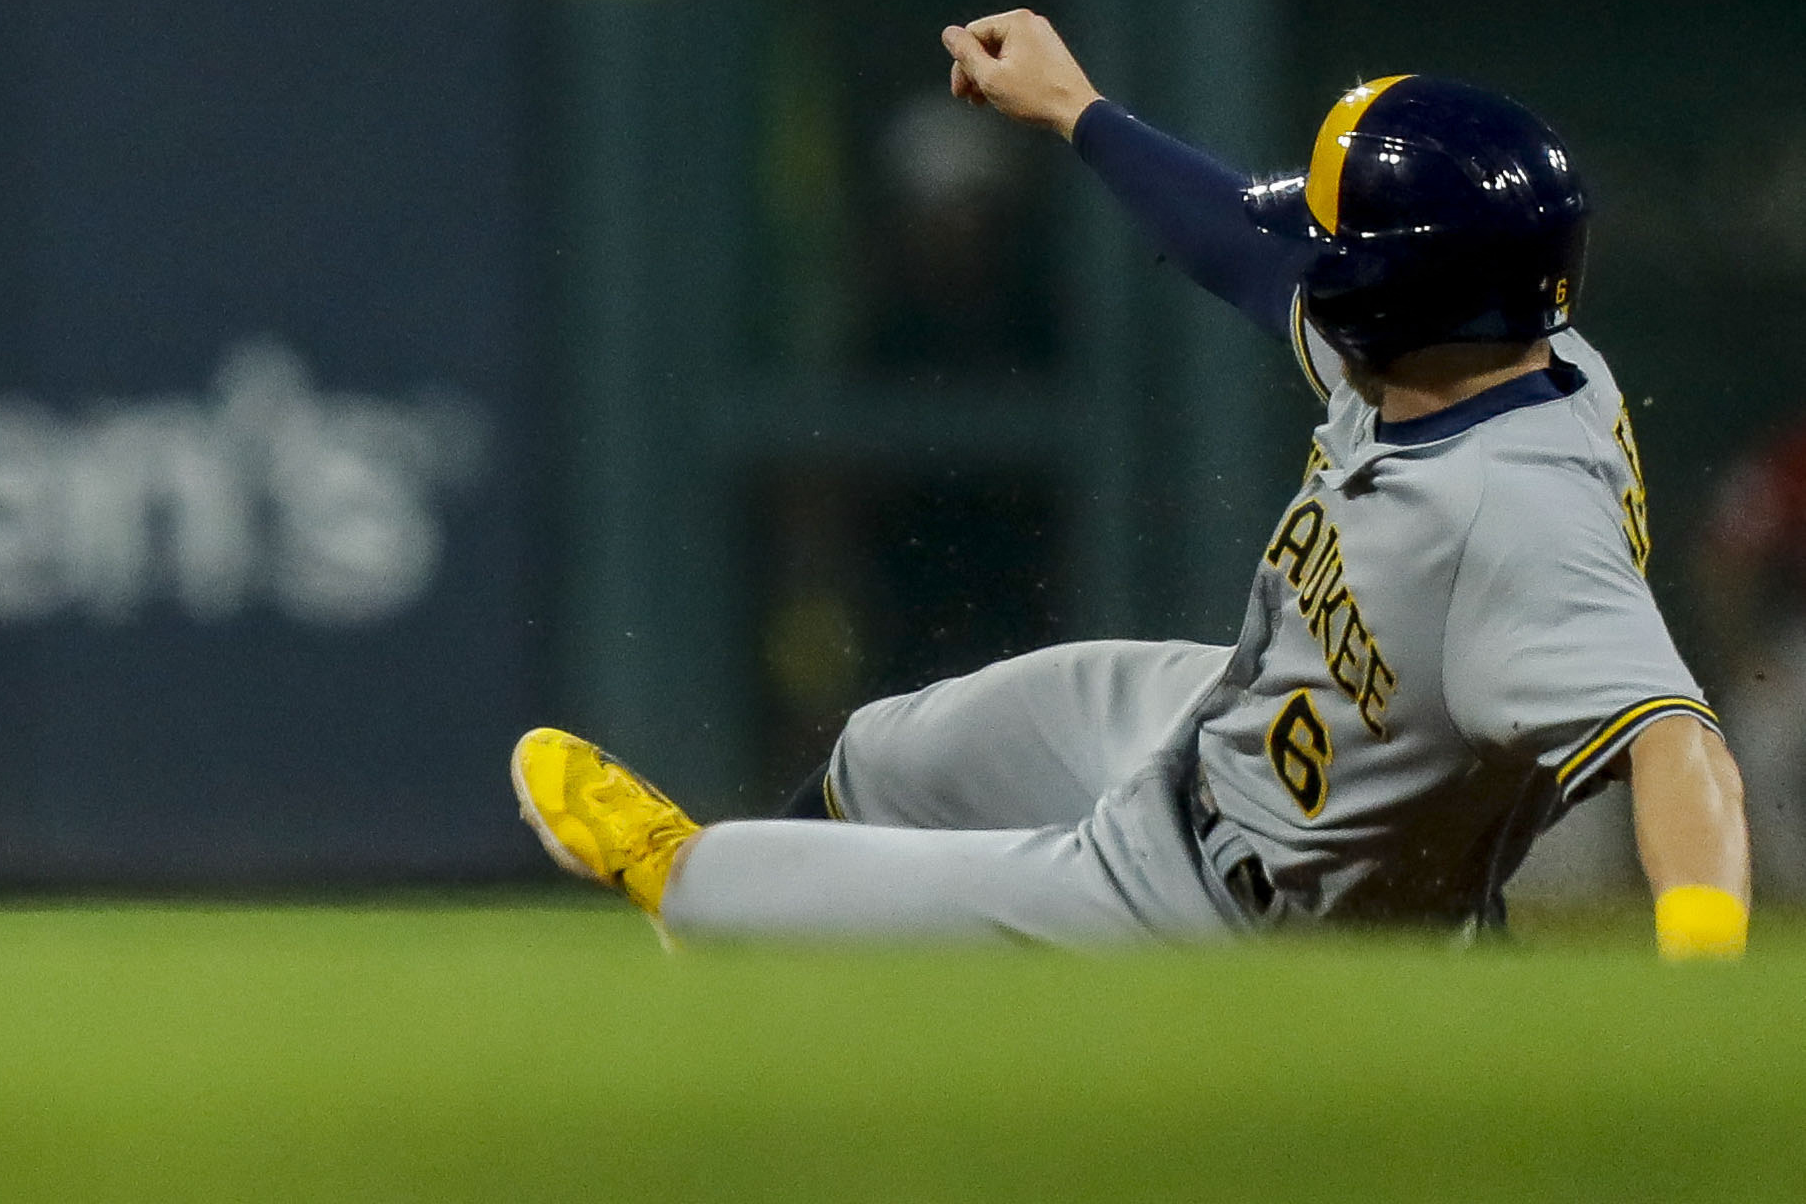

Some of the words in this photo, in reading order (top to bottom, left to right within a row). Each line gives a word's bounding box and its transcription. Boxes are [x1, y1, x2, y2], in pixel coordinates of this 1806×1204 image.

[1556, 278, 1567, 304] 6
[1265, 440, 1397, 740] AUKEE
[1266, 688, 1331, 819] 6
